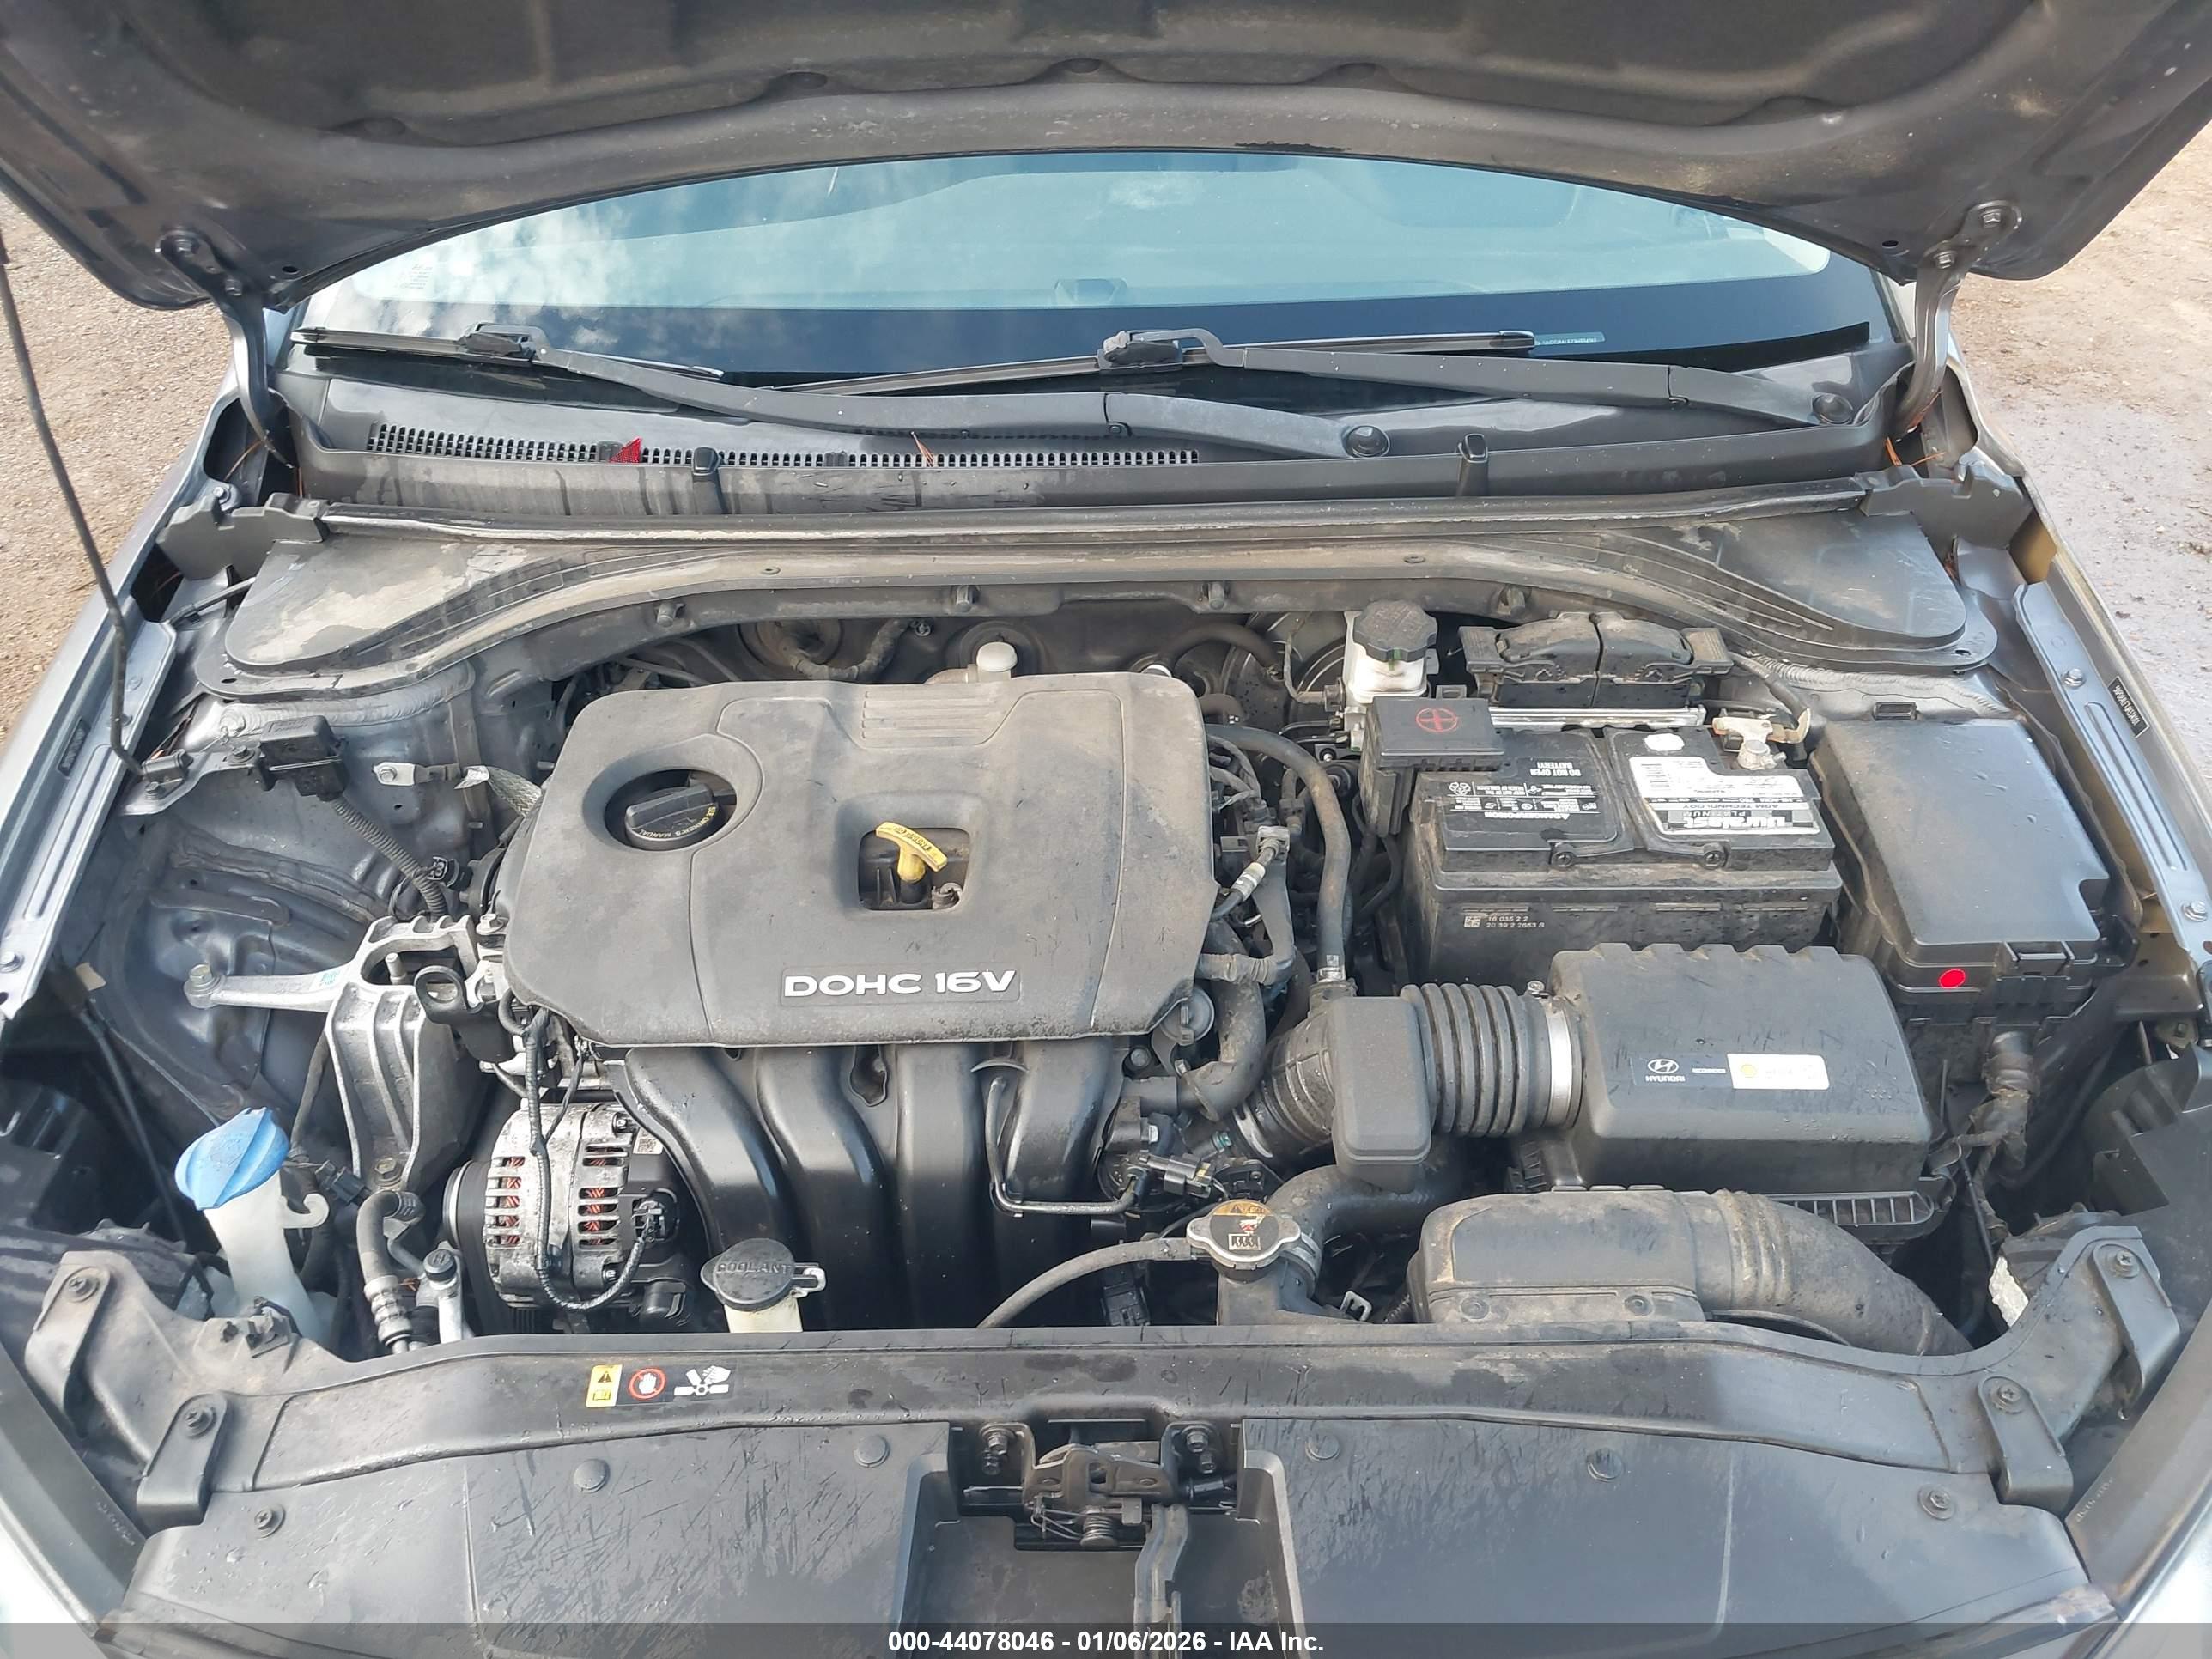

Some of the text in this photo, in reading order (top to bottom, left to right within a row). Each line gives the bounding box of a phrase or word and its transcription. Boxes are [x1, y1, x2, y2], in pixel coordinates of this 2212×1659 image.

[1685, 816, 1786, 828] Duralast
[639, 829, 672, 838] MANUAL
[785, 970, 1016, 997] DOHC 16V
[716, 1261, 791, 1274] COOLANT
